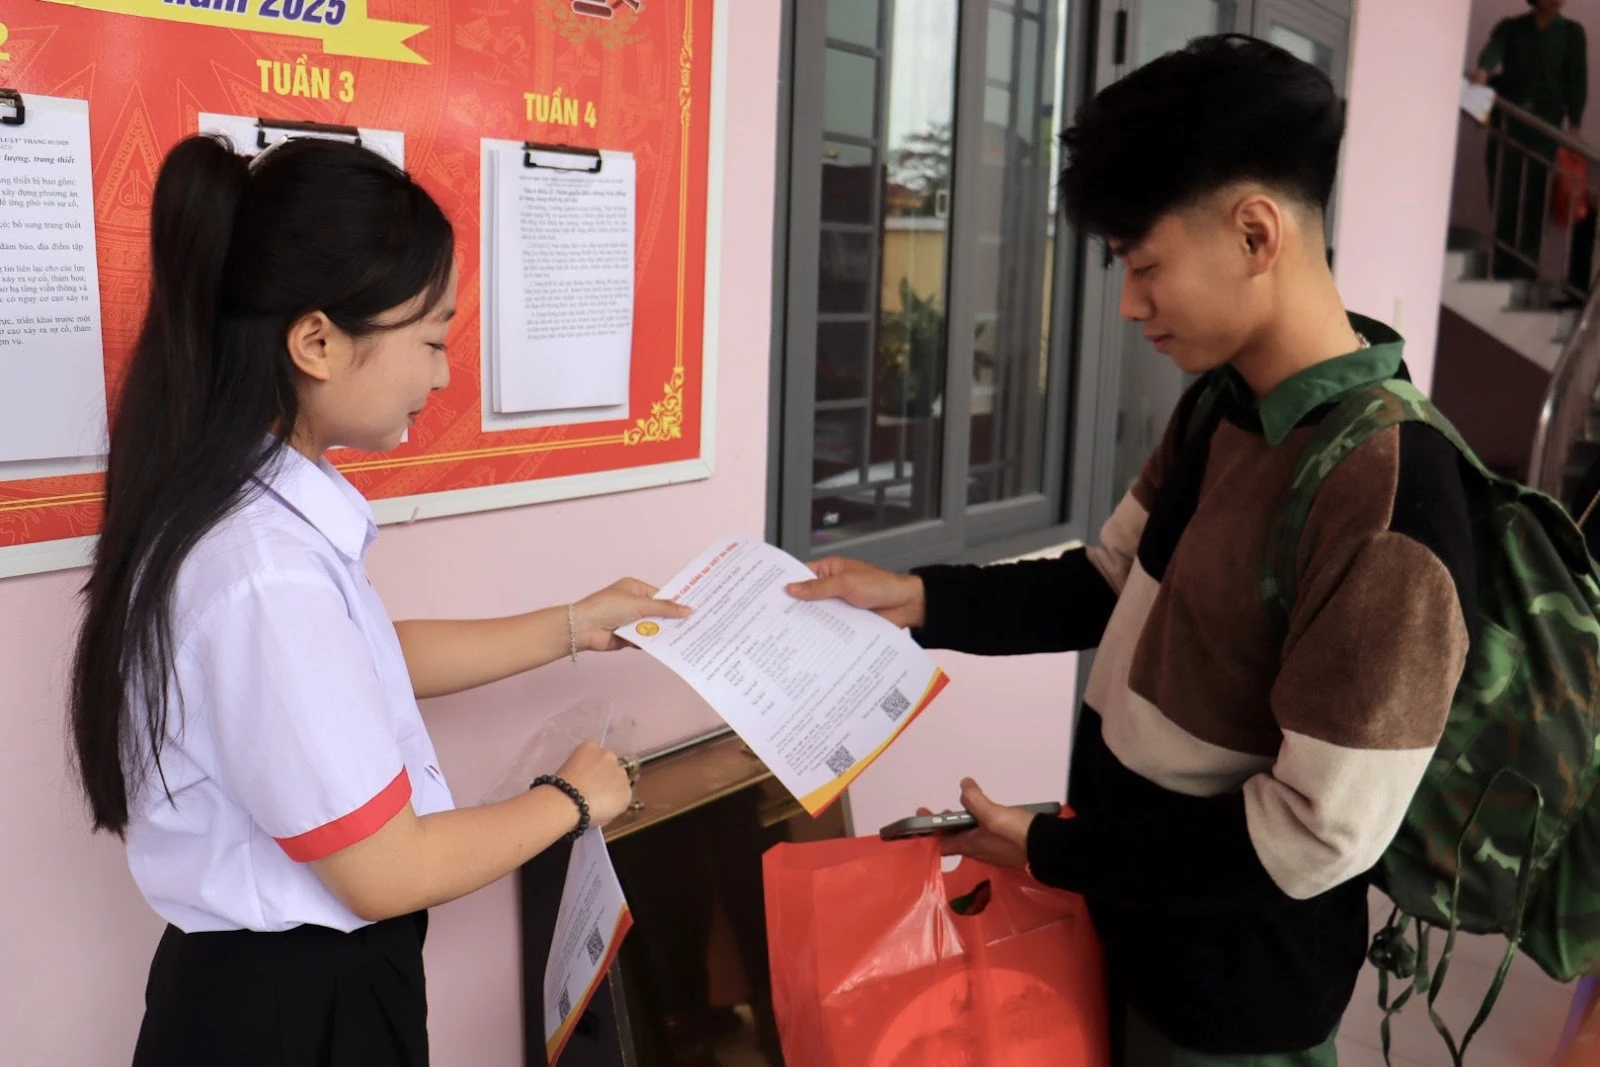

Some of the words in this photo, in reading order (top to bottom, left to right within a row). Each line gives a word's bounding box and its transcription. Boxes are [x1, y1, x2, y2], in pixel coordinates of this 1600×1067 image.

[256, 54, 331, 100] TUẦN
[338, 71, 355, 103] 3
[523, 87, 579, 127] TUẦN
[583, 101, 597, 128] 4
[33, 156, 55, 164] trang
[57, 155, 75, 164] thiết
